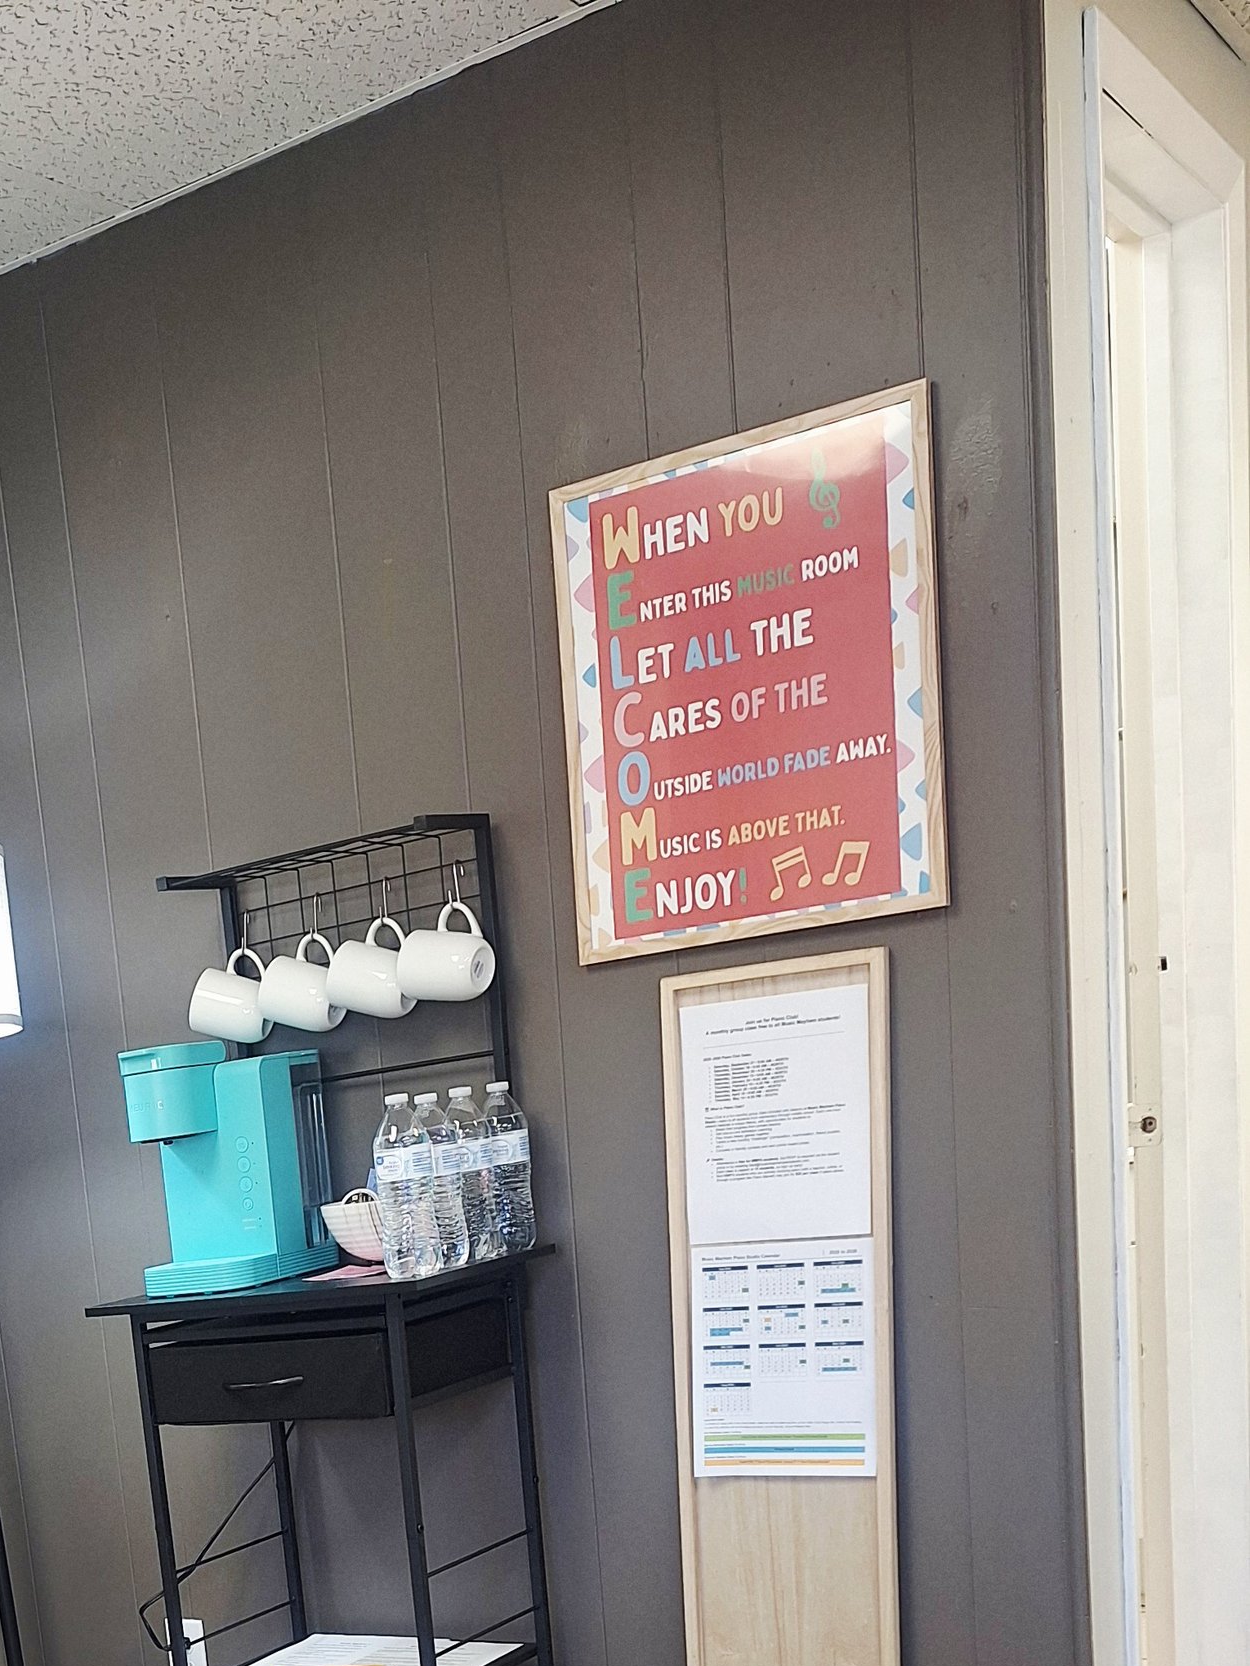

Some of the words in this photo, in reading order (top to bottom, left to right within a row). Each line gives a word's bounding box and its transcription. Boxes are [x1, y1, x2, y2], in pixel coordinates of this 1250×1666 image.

[602, 505, 710, 570] WHEN
[717, 486, 783, 537] YOU
[606, 570, 687, 631] ENTER
[691, 580, 733, 609] THIS
[736, 563, 796, 597] MUSIC
[801, 546, 859, 582] ROOM
[609, 635, 675, 690] LET
[684, 628, 741, 673] ALL
[750, 608, 814, 656] THE
[613, 691, 722, 748] CARES
[731, 686, 767, 723] OF
[774, 672, 829, 713] THE
[618, 751, 713, 806] OUTSIDE
[717, 756, 779, 788] WORLD
[783, 746, 831, 774] FADE
[836, 733, 892, 764] AWAY.
[620, 807, 701, 866] MUSIC
[706, 828, 723, 850] IS
[727, 814, 791, 846] ABOVE
[795, 805, 846, 833] THAT.
